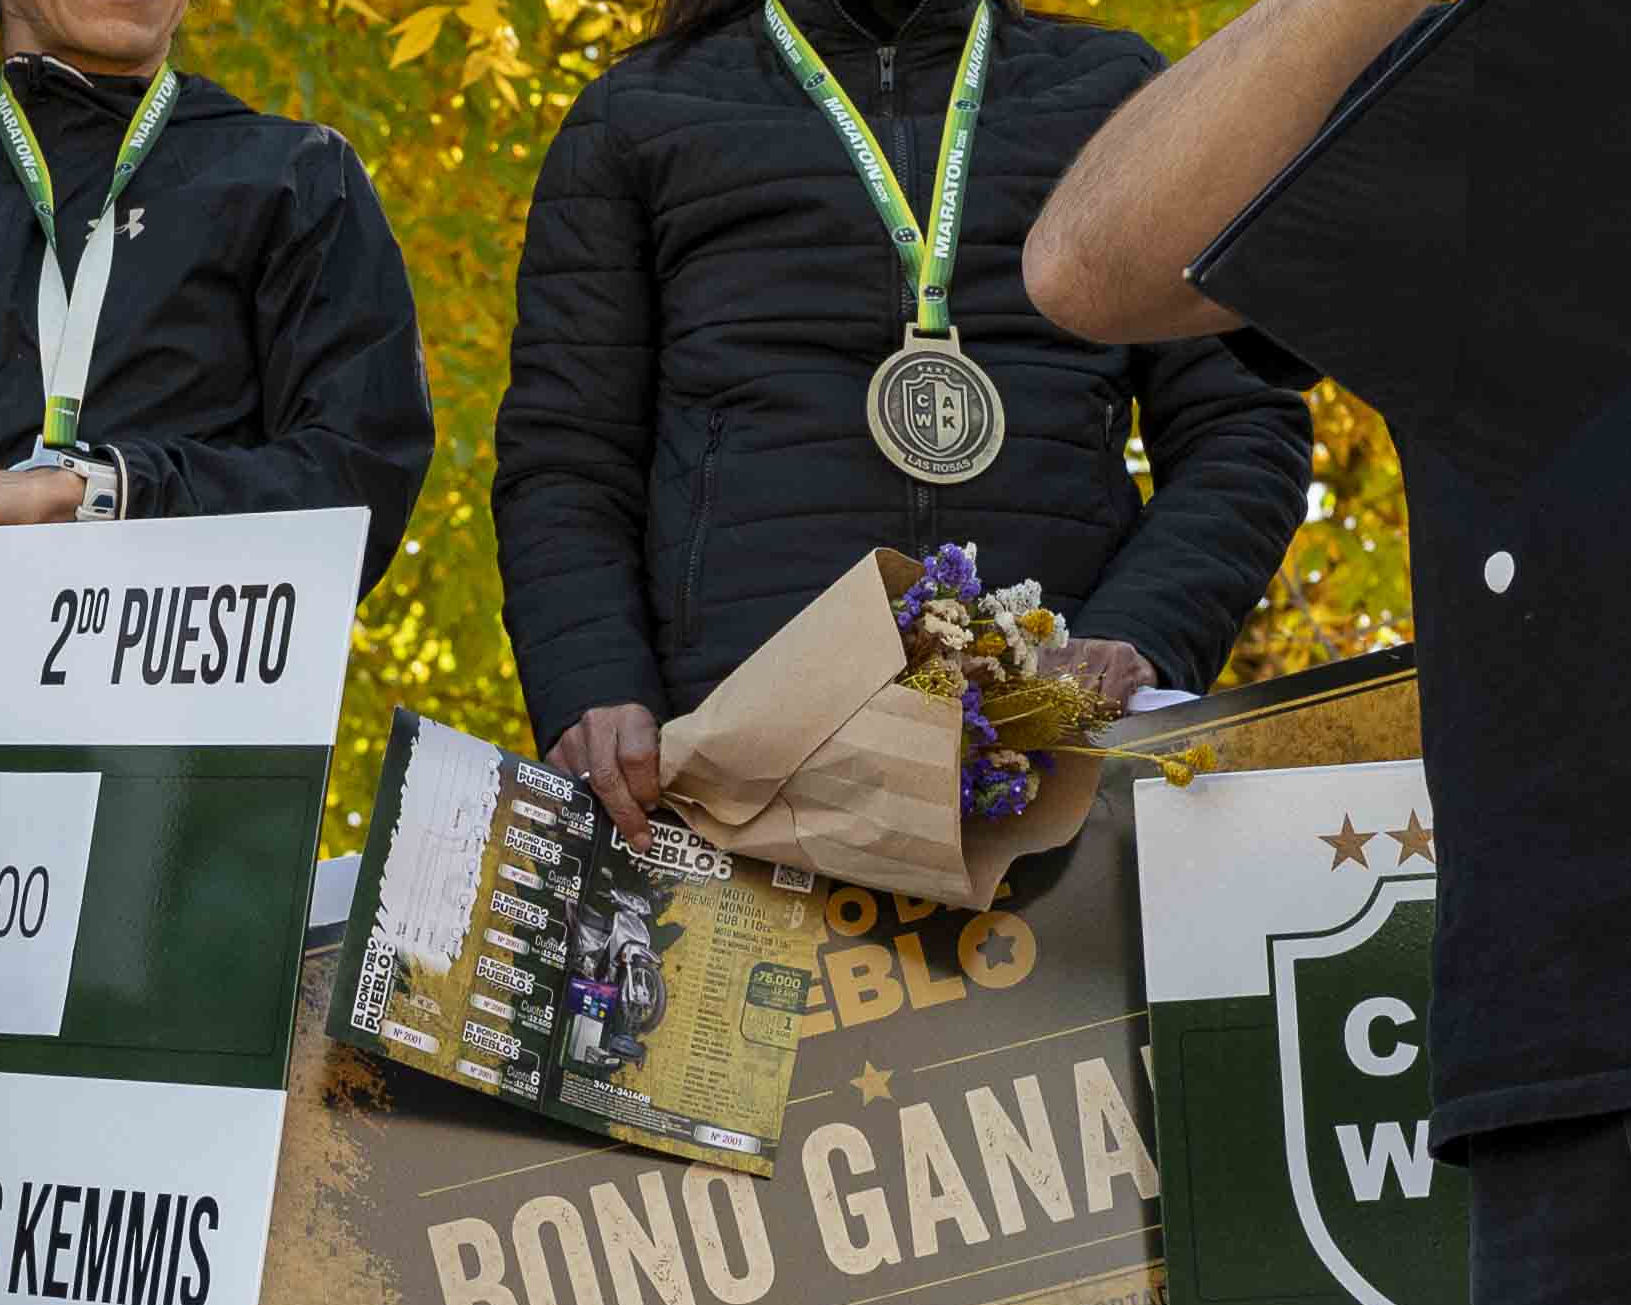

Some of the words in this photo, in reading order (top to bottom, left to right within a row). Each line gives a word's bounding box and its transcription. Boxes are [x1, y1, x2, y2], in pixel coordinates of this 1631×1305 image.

[130, 71, 177, 149] MARATON
[824, 96, 884, 188] MARATON
[935, 148, 964, 259] MARATON
[915, 413, 932, 426] W
[943, 416, 955, 429] K
[917, 394, 929, 407] C
[943, 397, 955, 409] A
[907, 454, 931, 471] LAS
[932, 458, 971, 472] ROSAS
[111, 582, 296, 686] PUESTO
[357, 977, 371, 1009] BONO
[365, 954, 392, 1030] PUEBLO
[403, 1030, 422, 1046] 2001
[1344, 997, 1419, 1075] C
[800, 1041, 1160, 1276] GANA
[1336, 1119, 1436, 1202] W
